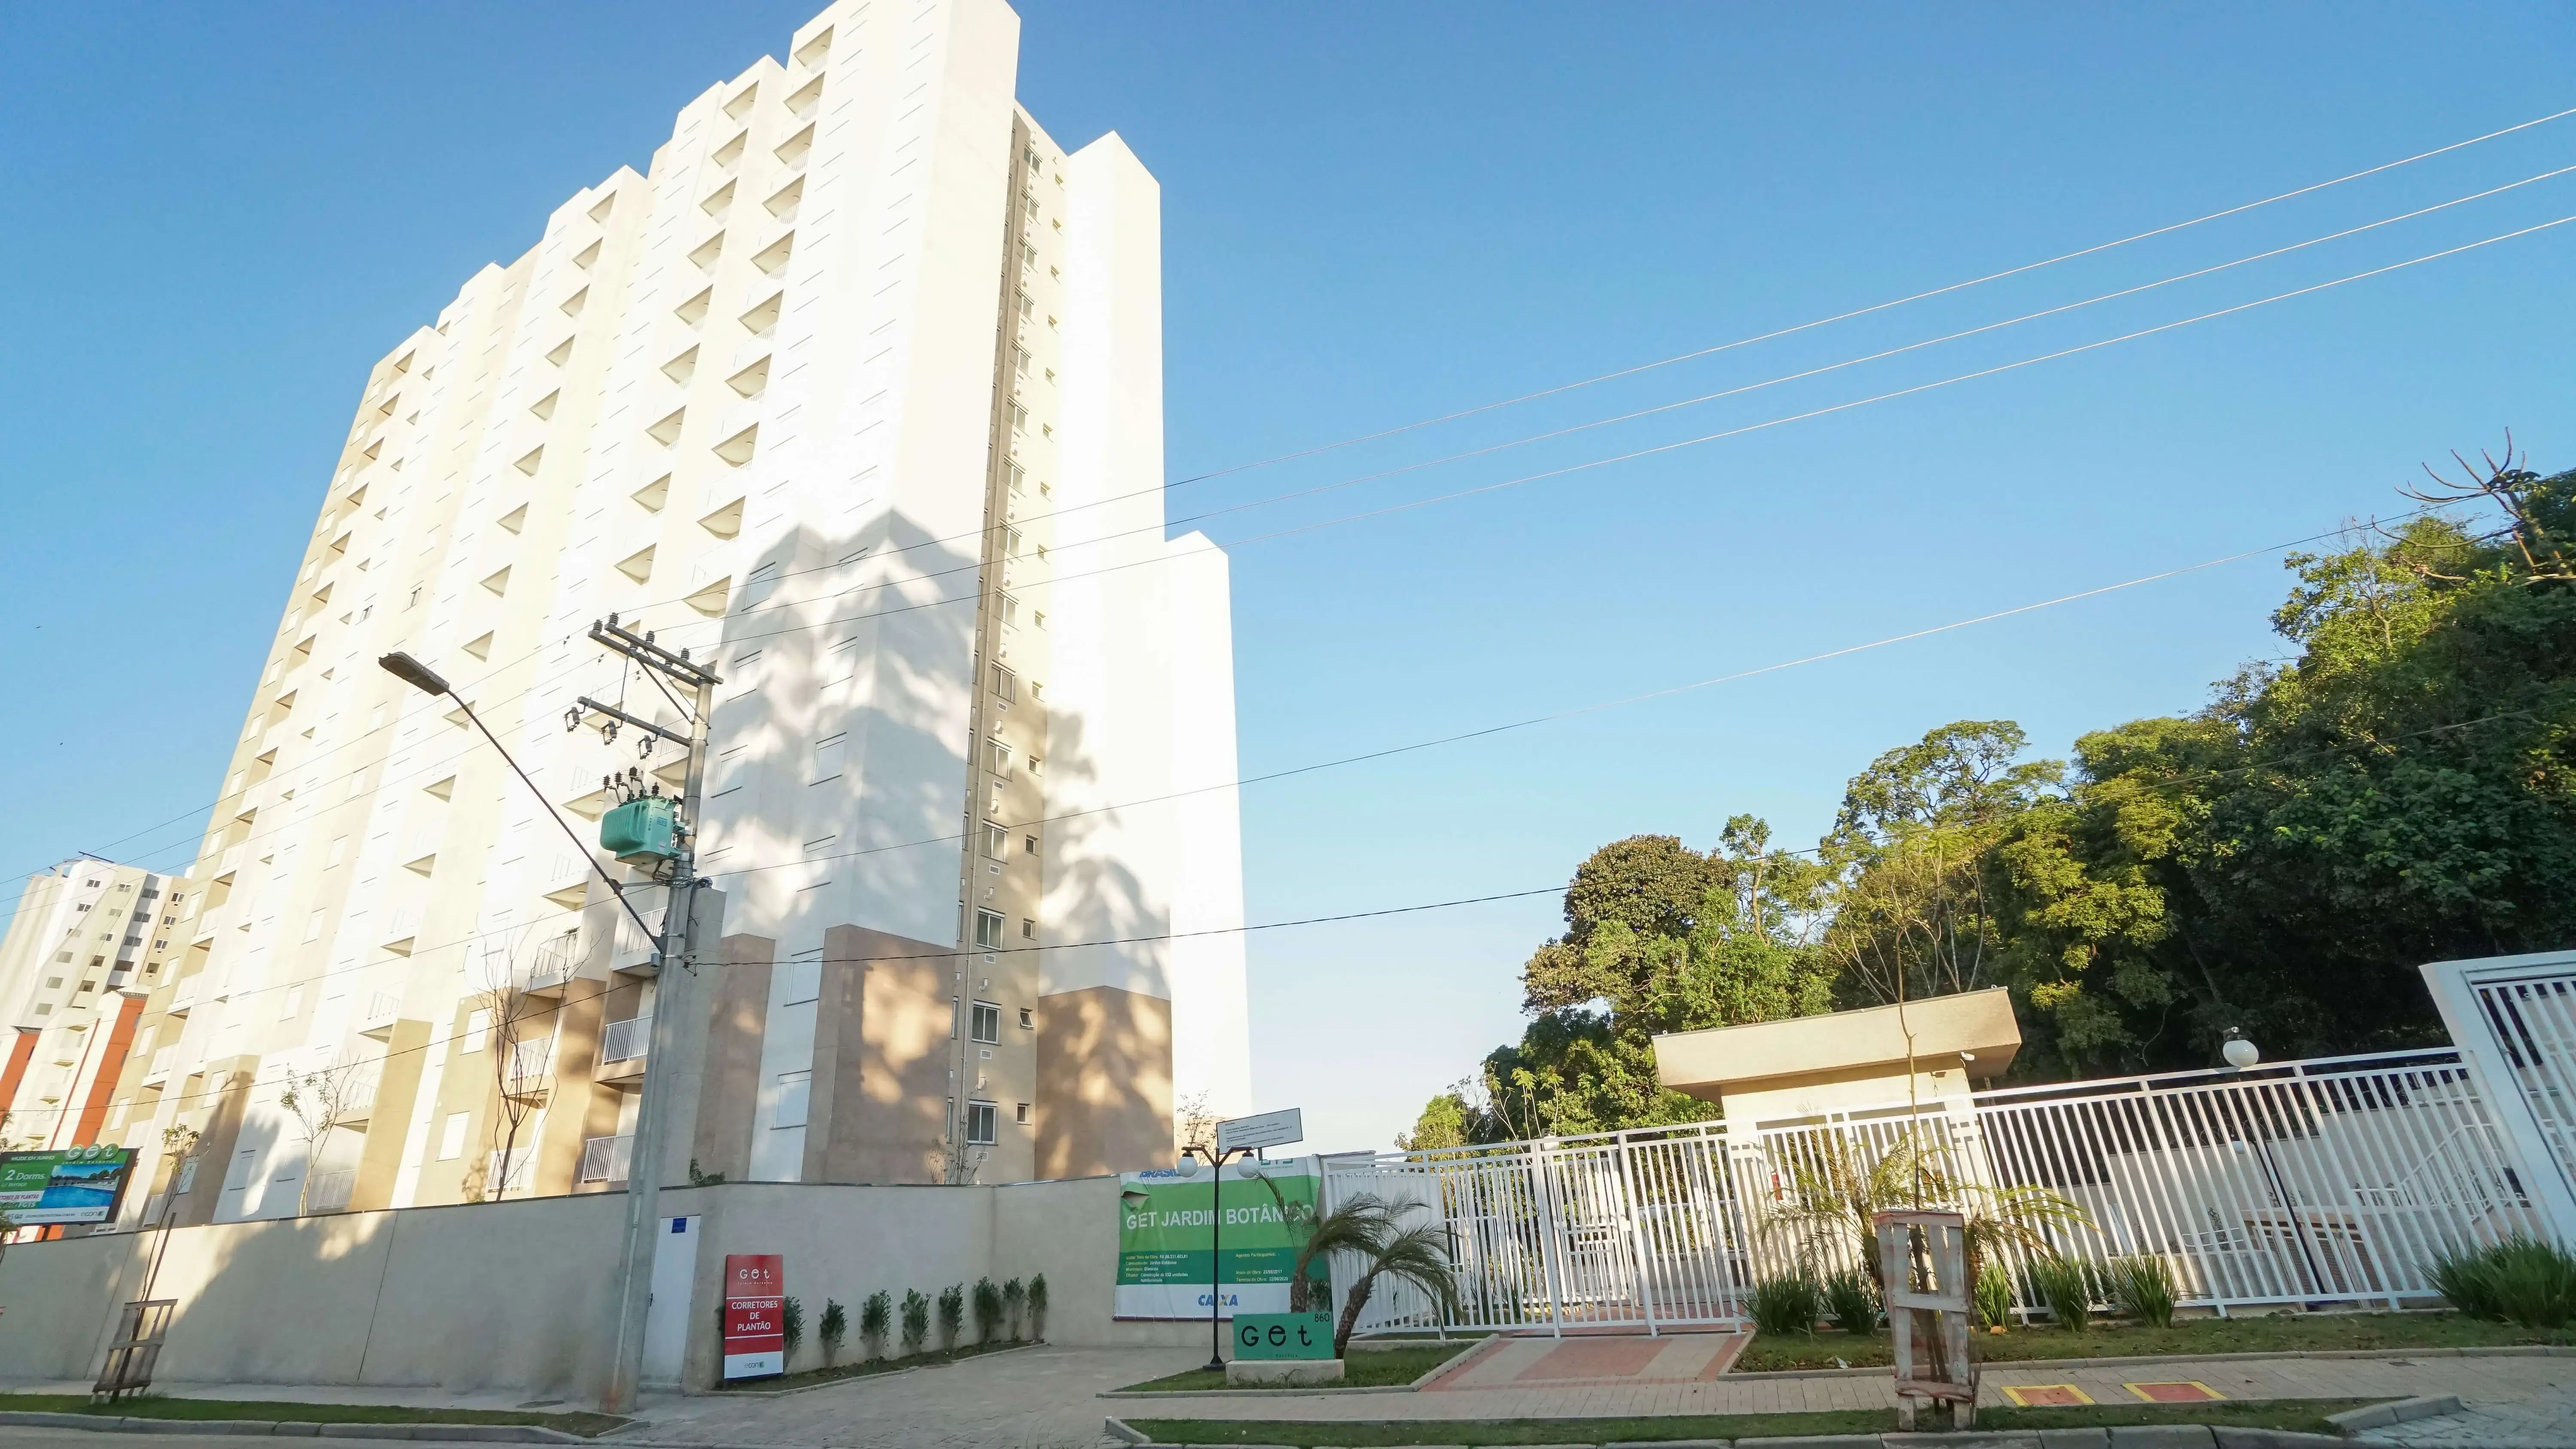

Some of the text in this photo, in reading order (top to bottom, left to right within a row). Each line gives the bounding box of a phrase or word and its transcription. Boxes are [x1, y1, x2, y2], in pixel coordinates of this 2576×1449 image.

[68, 1146, 114, 1158] Get
[4, 1169, 15, 1181] 2
[1127, 1212, 1157, 1230] GET
[1161, 1210, 1221, 1227] JARDIM
[740, 1268, 770, 1279] Get
[732, 1300, 778, 1309] CORRETORES
[1198, 1294, 1238, 1306] CAXA
[750, 1312, 759, 1320] DE
[1315, 1313, 1330, 1322] 860
[738, 1321, 771, 1331] PLANTÃO
[1241, 1325, 1312, 1346] Get
